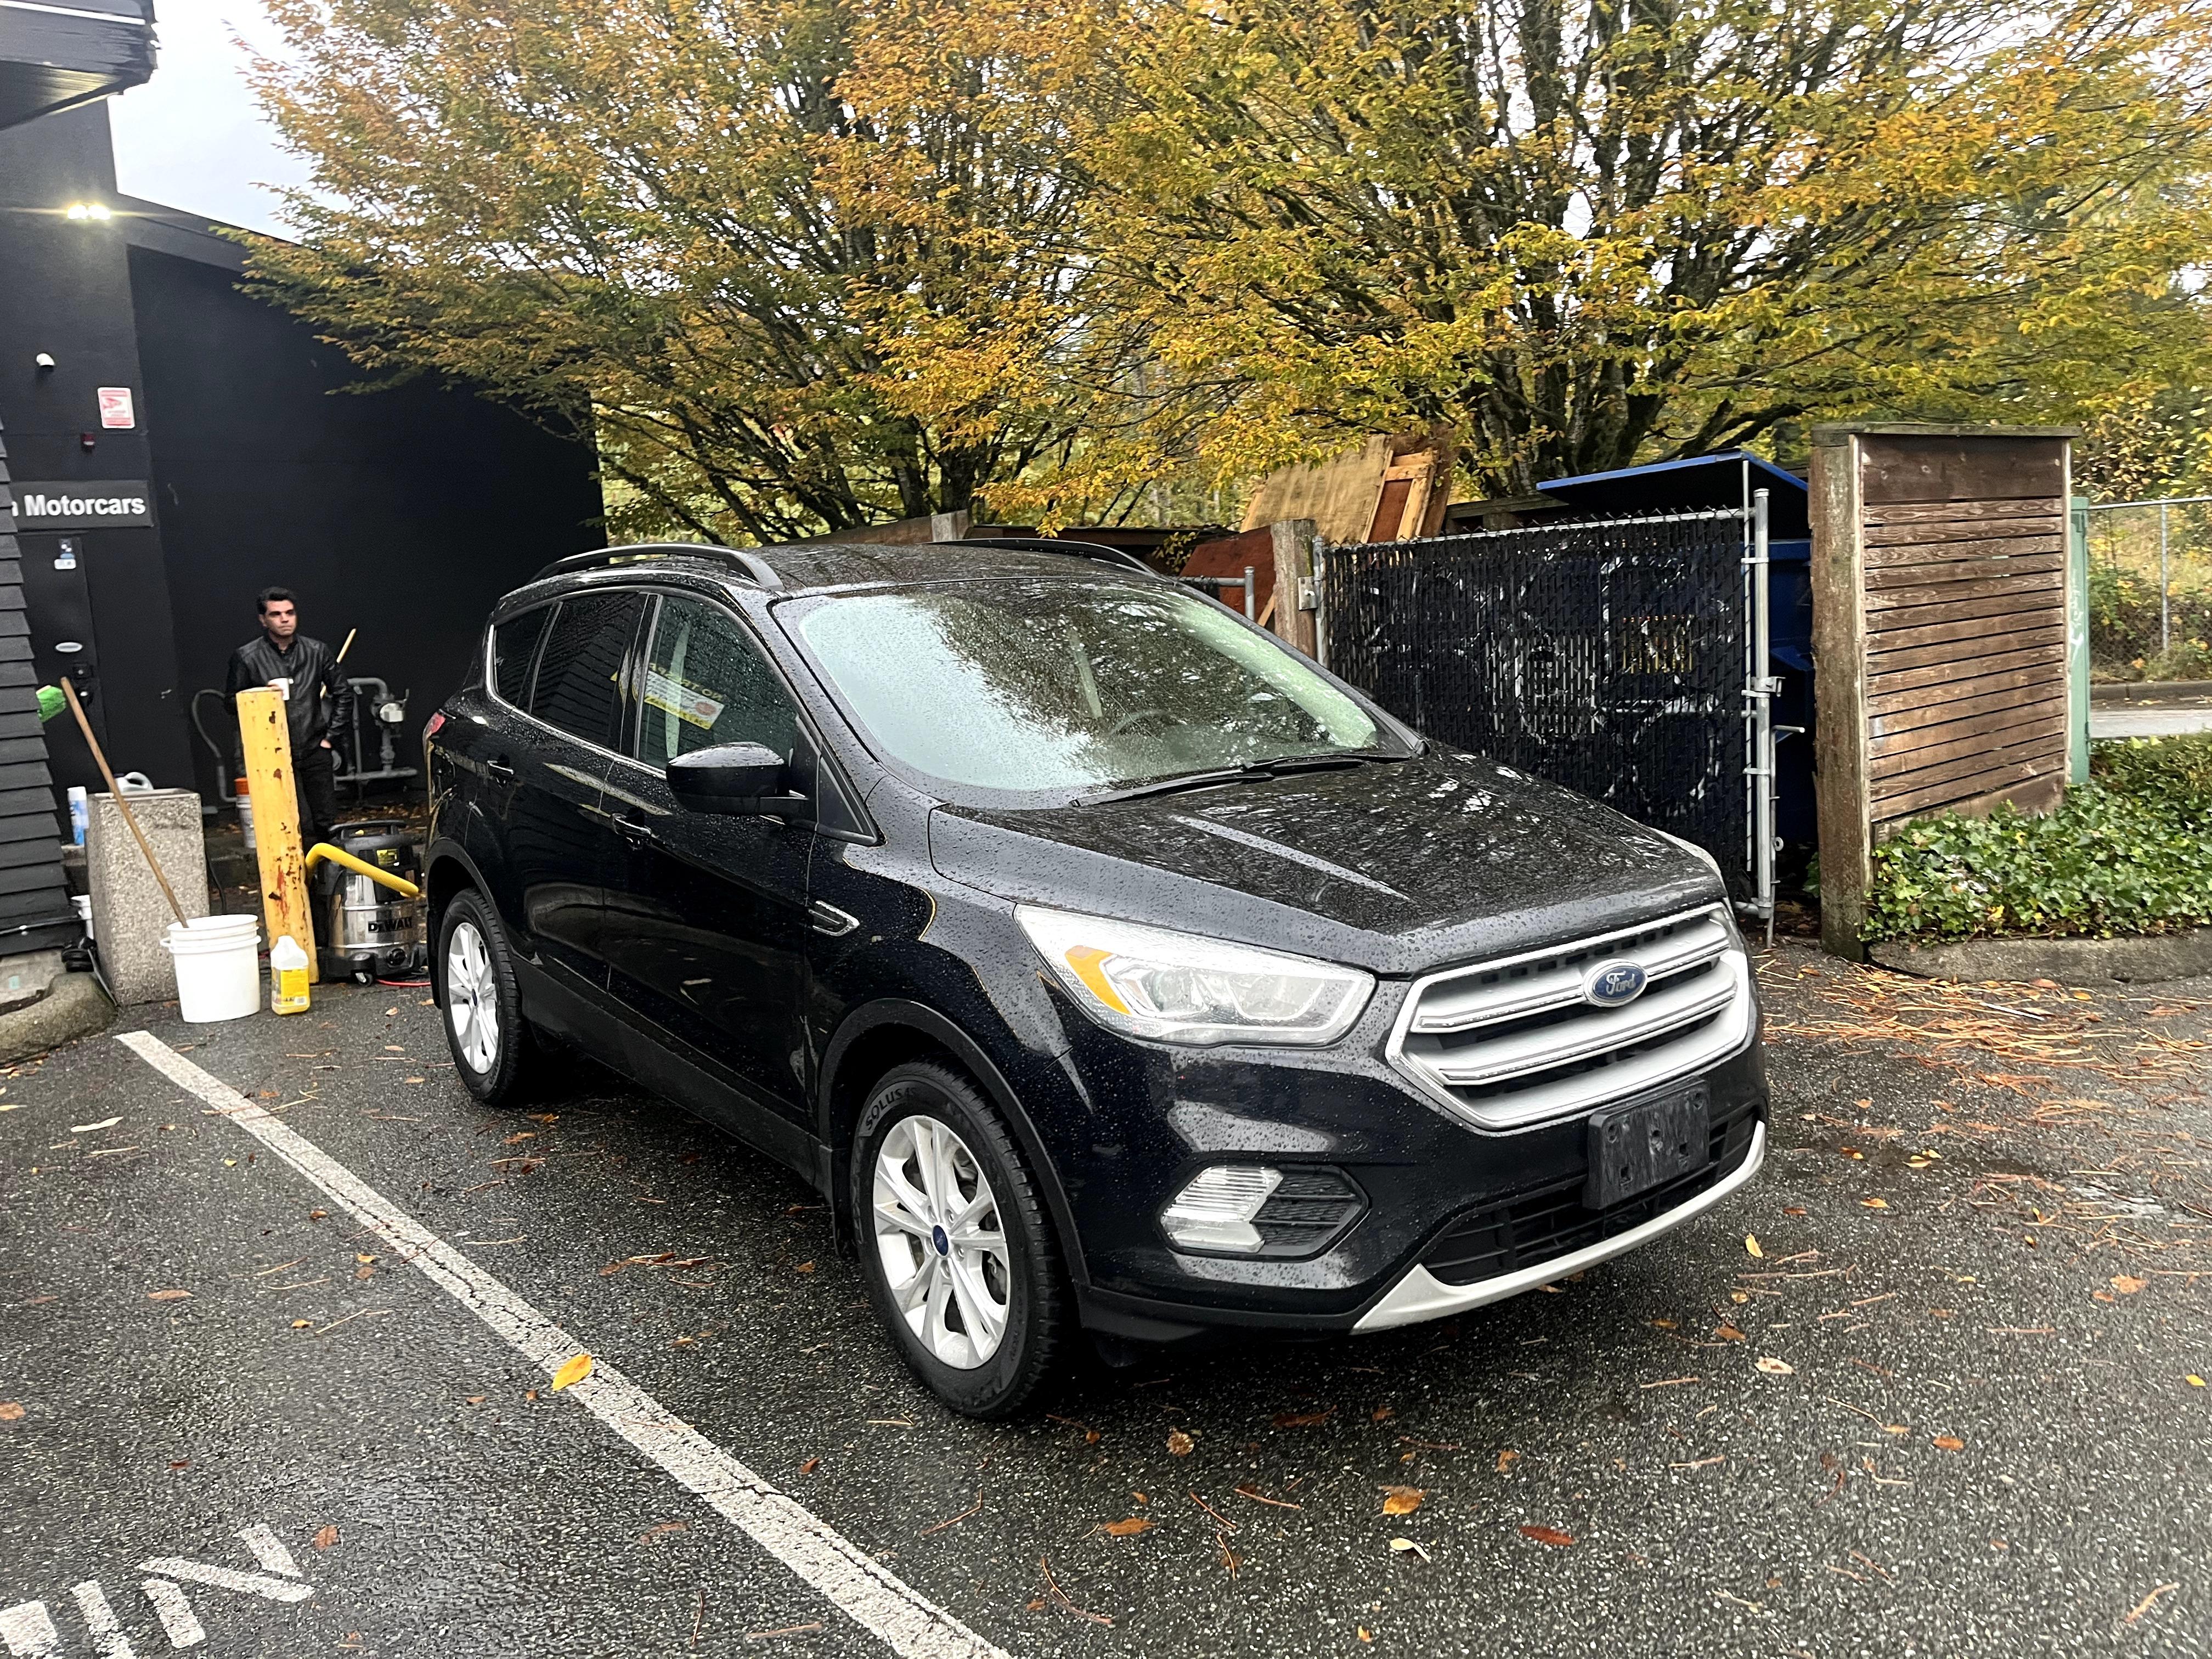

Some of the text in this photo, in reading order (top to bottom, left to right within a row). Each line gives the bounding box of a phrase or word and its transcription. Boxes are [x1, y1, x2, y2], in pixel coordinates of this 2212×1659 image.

[24, 494, 146, 516] Motorcars
[1606, 970, 1636, 996] Ford
[866, 1088, 904, 1130] SOLUS
